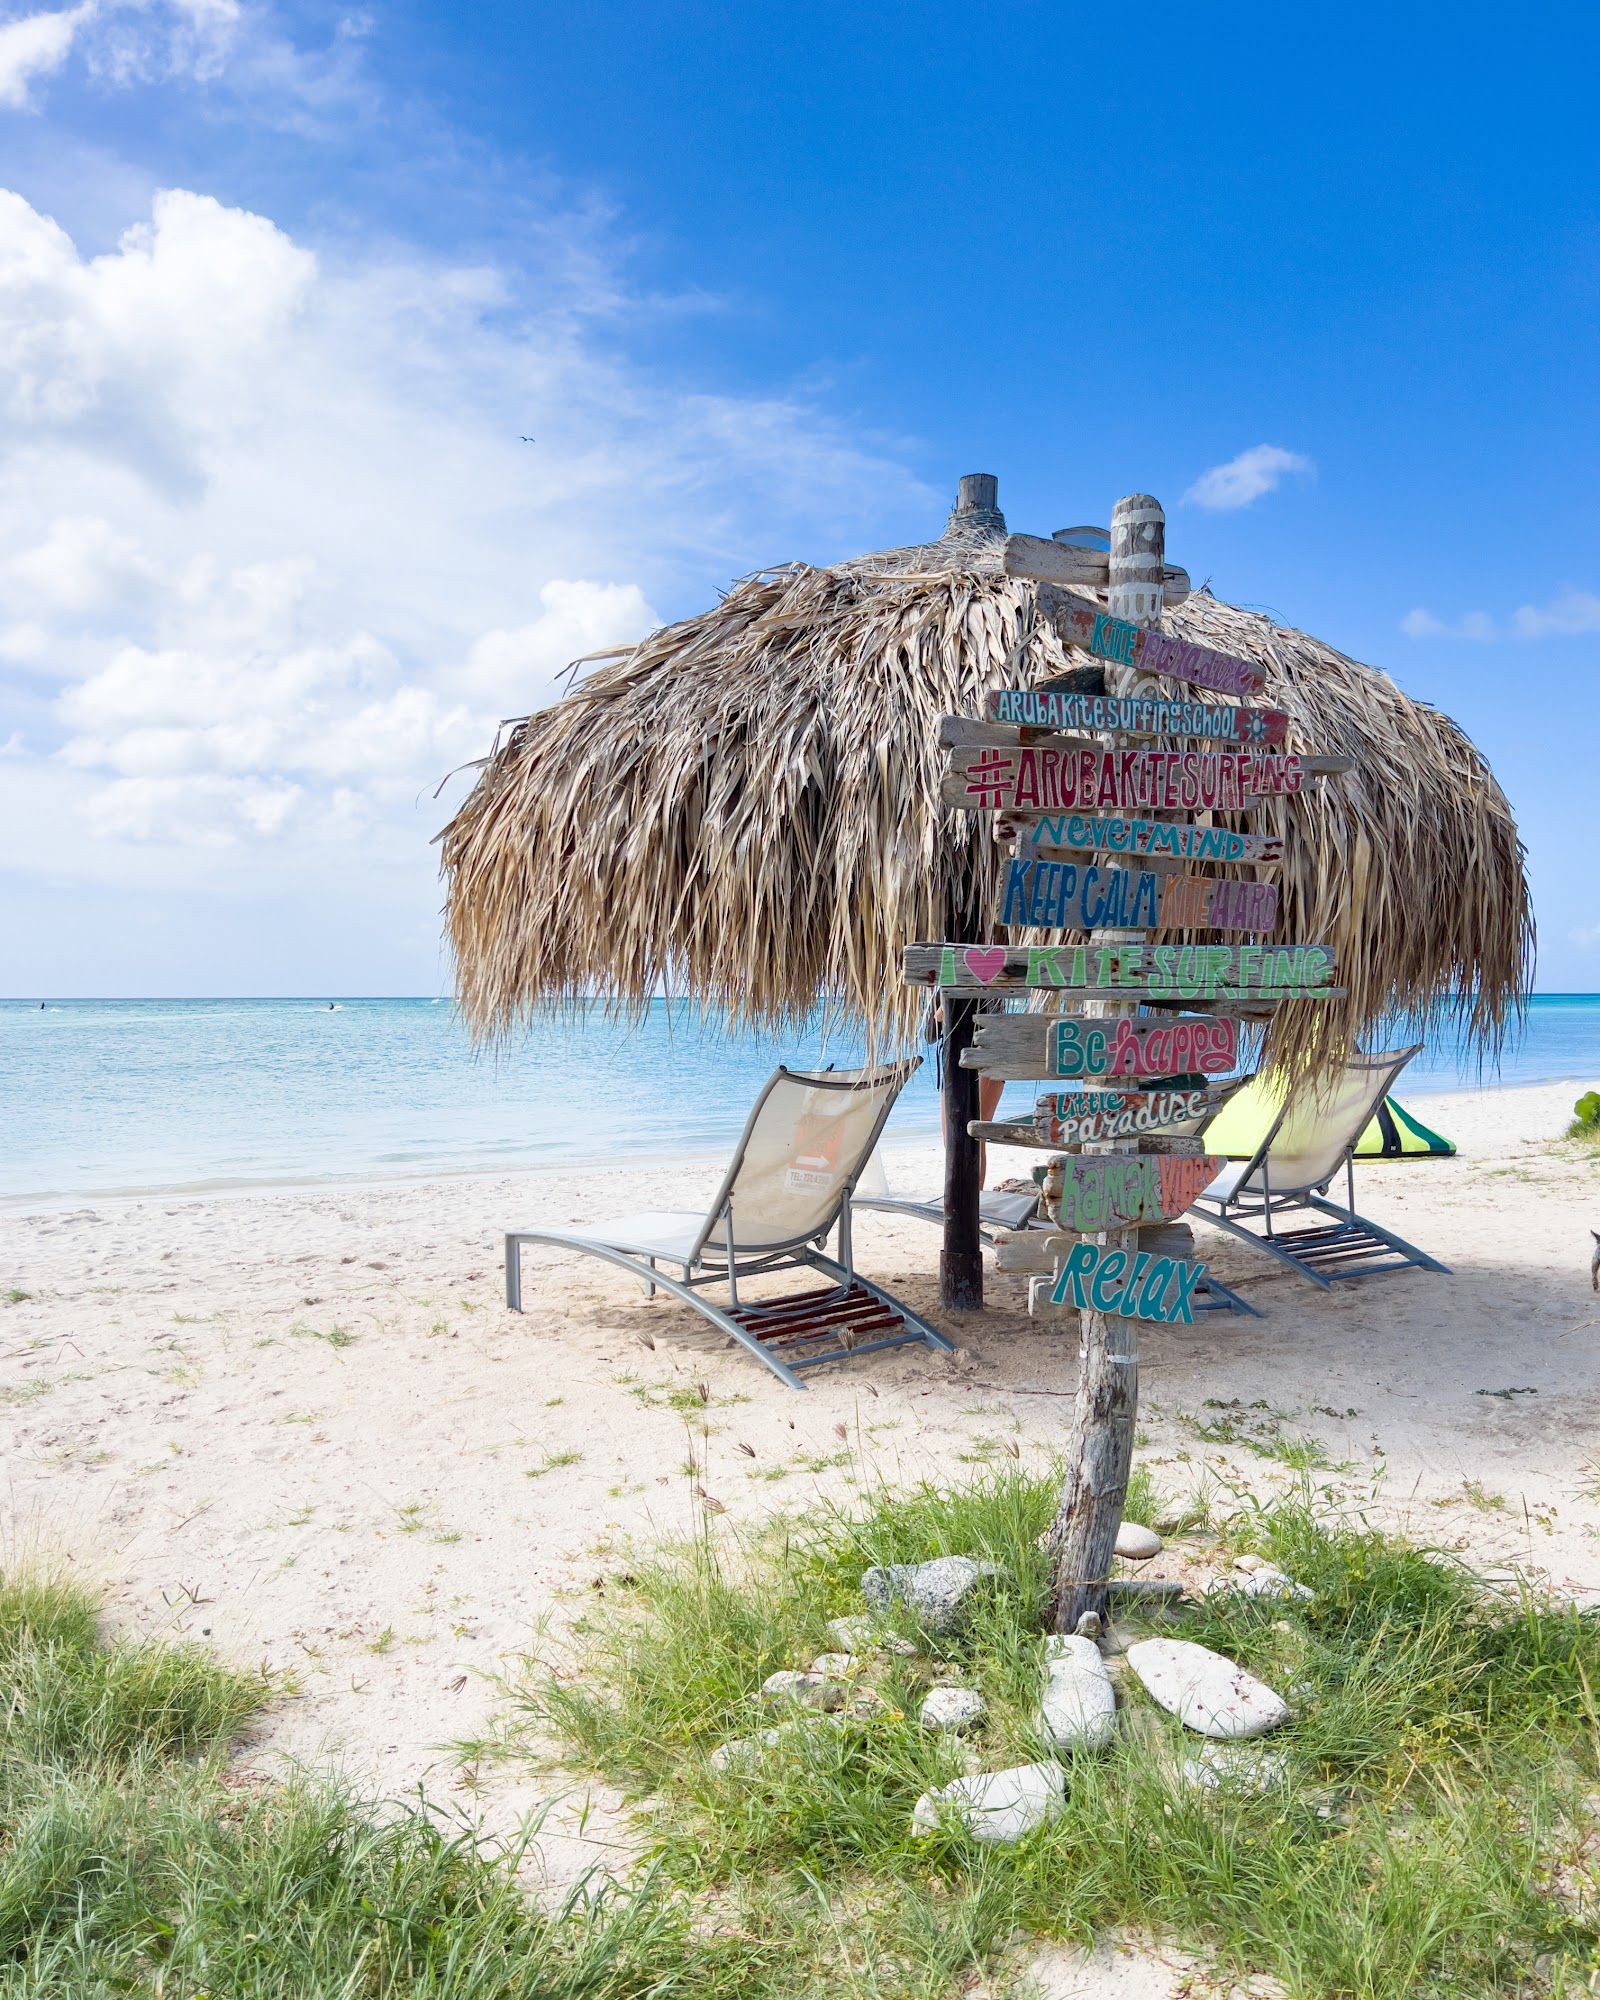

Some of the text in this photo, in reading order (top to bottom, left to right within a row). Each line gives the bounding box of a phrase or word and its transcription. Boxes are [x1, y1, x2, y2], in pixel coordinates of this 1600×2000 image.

[1002, 858, 1077, 927] KEEP
[1081, 865, 1157, 929] CALM
[1211, 880, 1279, 932] HARD
[1056, 1018, 1236, 1076] Be happy
[1052, 1243, 1206, 1324] Relax
